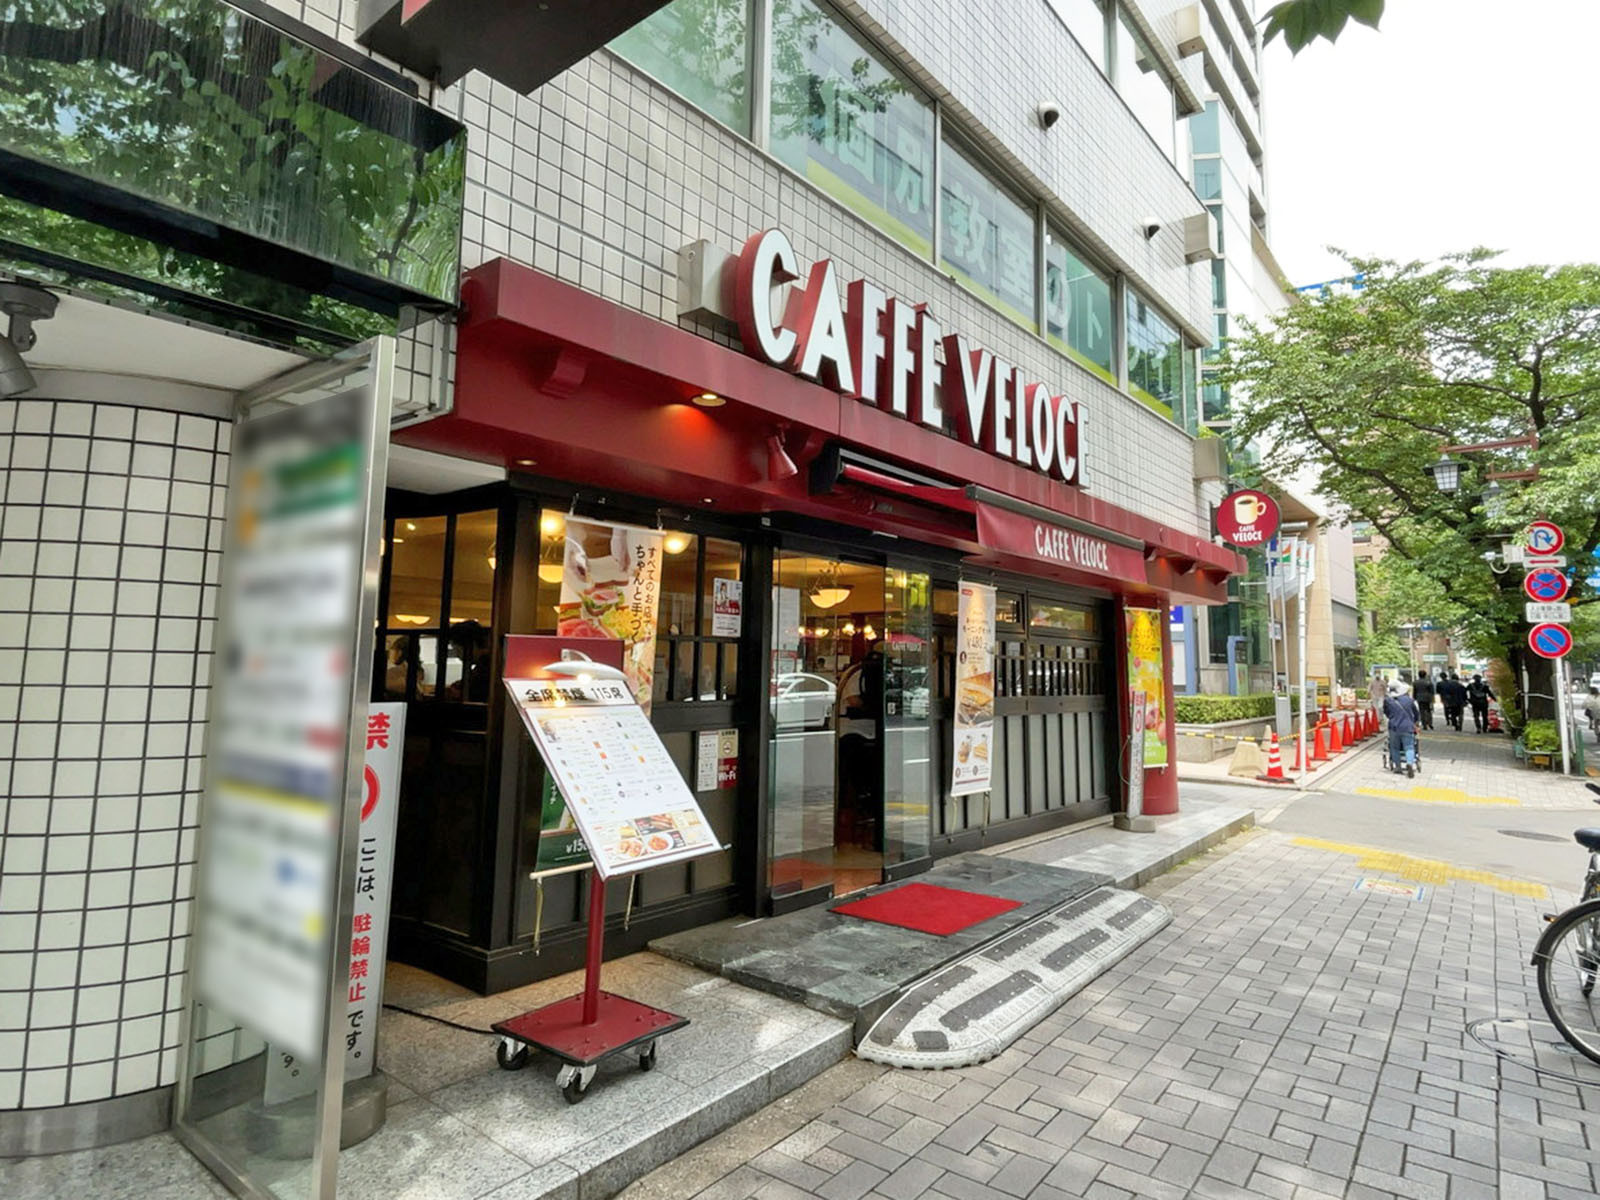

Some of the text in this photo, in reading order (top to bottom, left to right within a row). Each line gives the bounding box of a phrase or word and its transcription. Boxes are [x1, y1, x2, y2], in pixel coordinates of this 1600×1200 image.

[950, 334, 1090, 489] VELOCE
[1071, 534, 1108, 571] VELOCE
[1232, 531, 1262, 542] VELOCE
